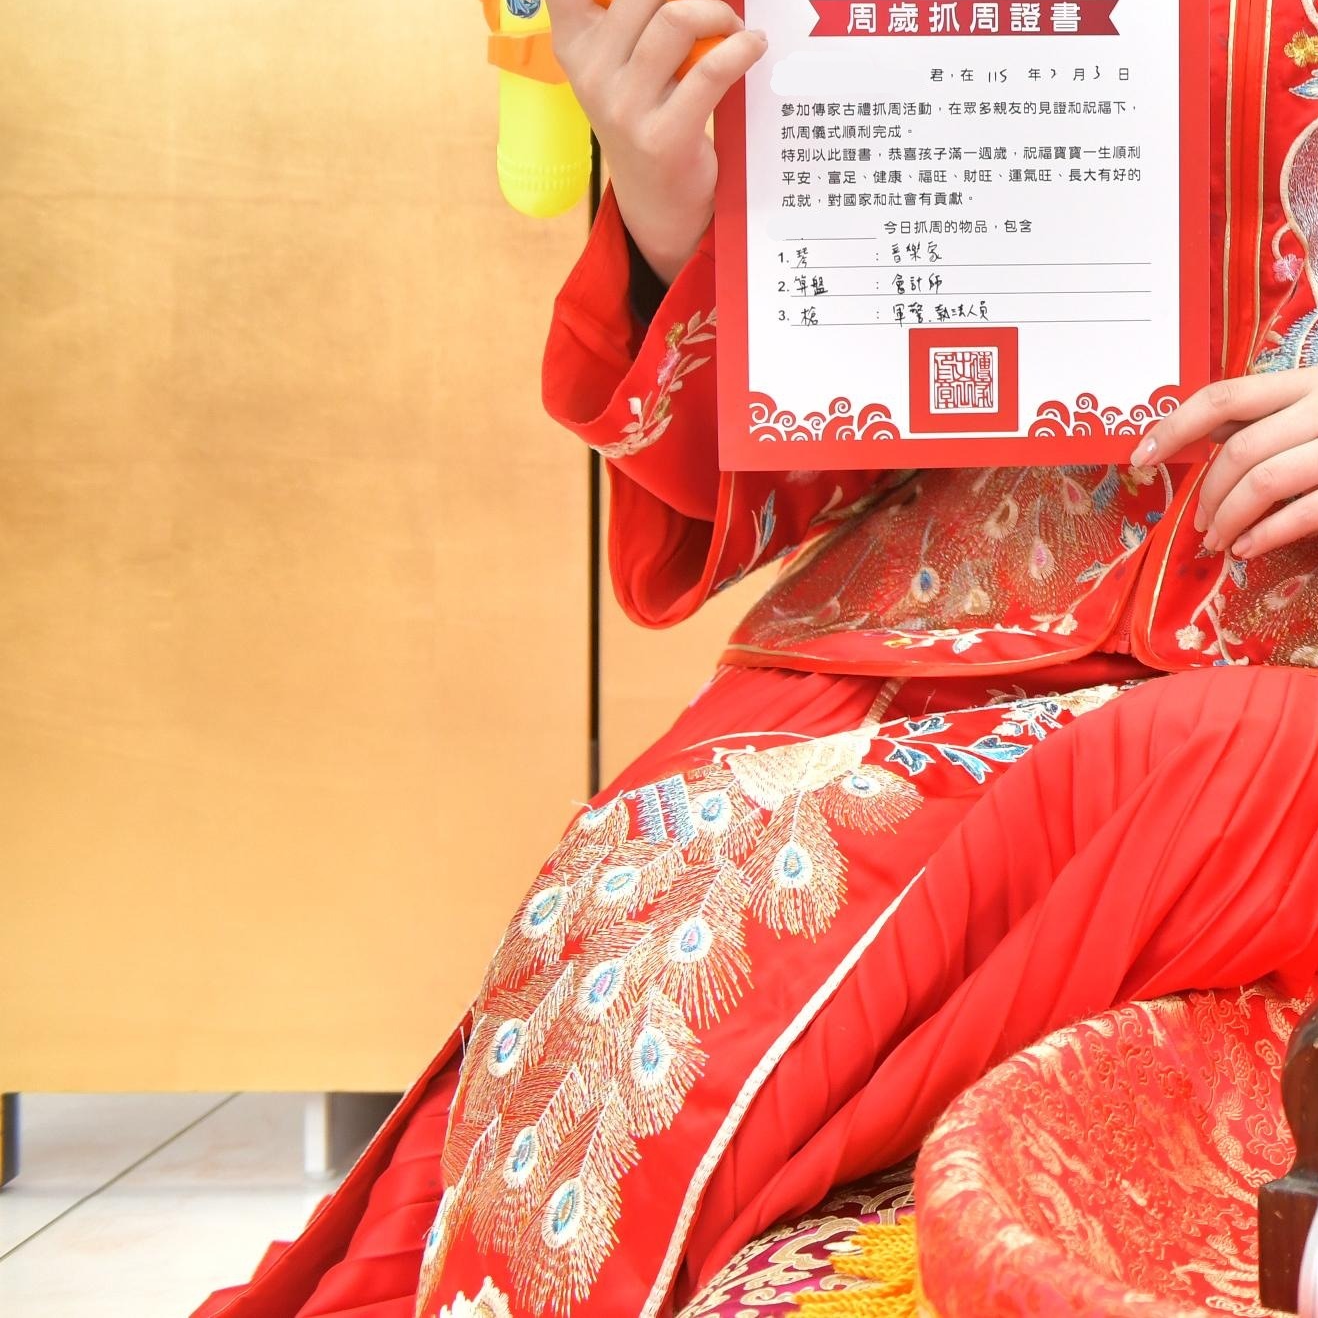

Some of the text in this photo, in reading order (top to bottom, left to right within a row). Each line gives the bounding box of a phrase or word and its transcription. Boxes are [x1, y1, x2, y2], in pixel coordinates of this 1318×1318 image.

[847, 1, 1082, 34] 周歲抓周證書
[1028, 68, 1041, 82] 年
[1073, 68, 1085, 82] 月
[1119, 68, 1129, 81] 日
